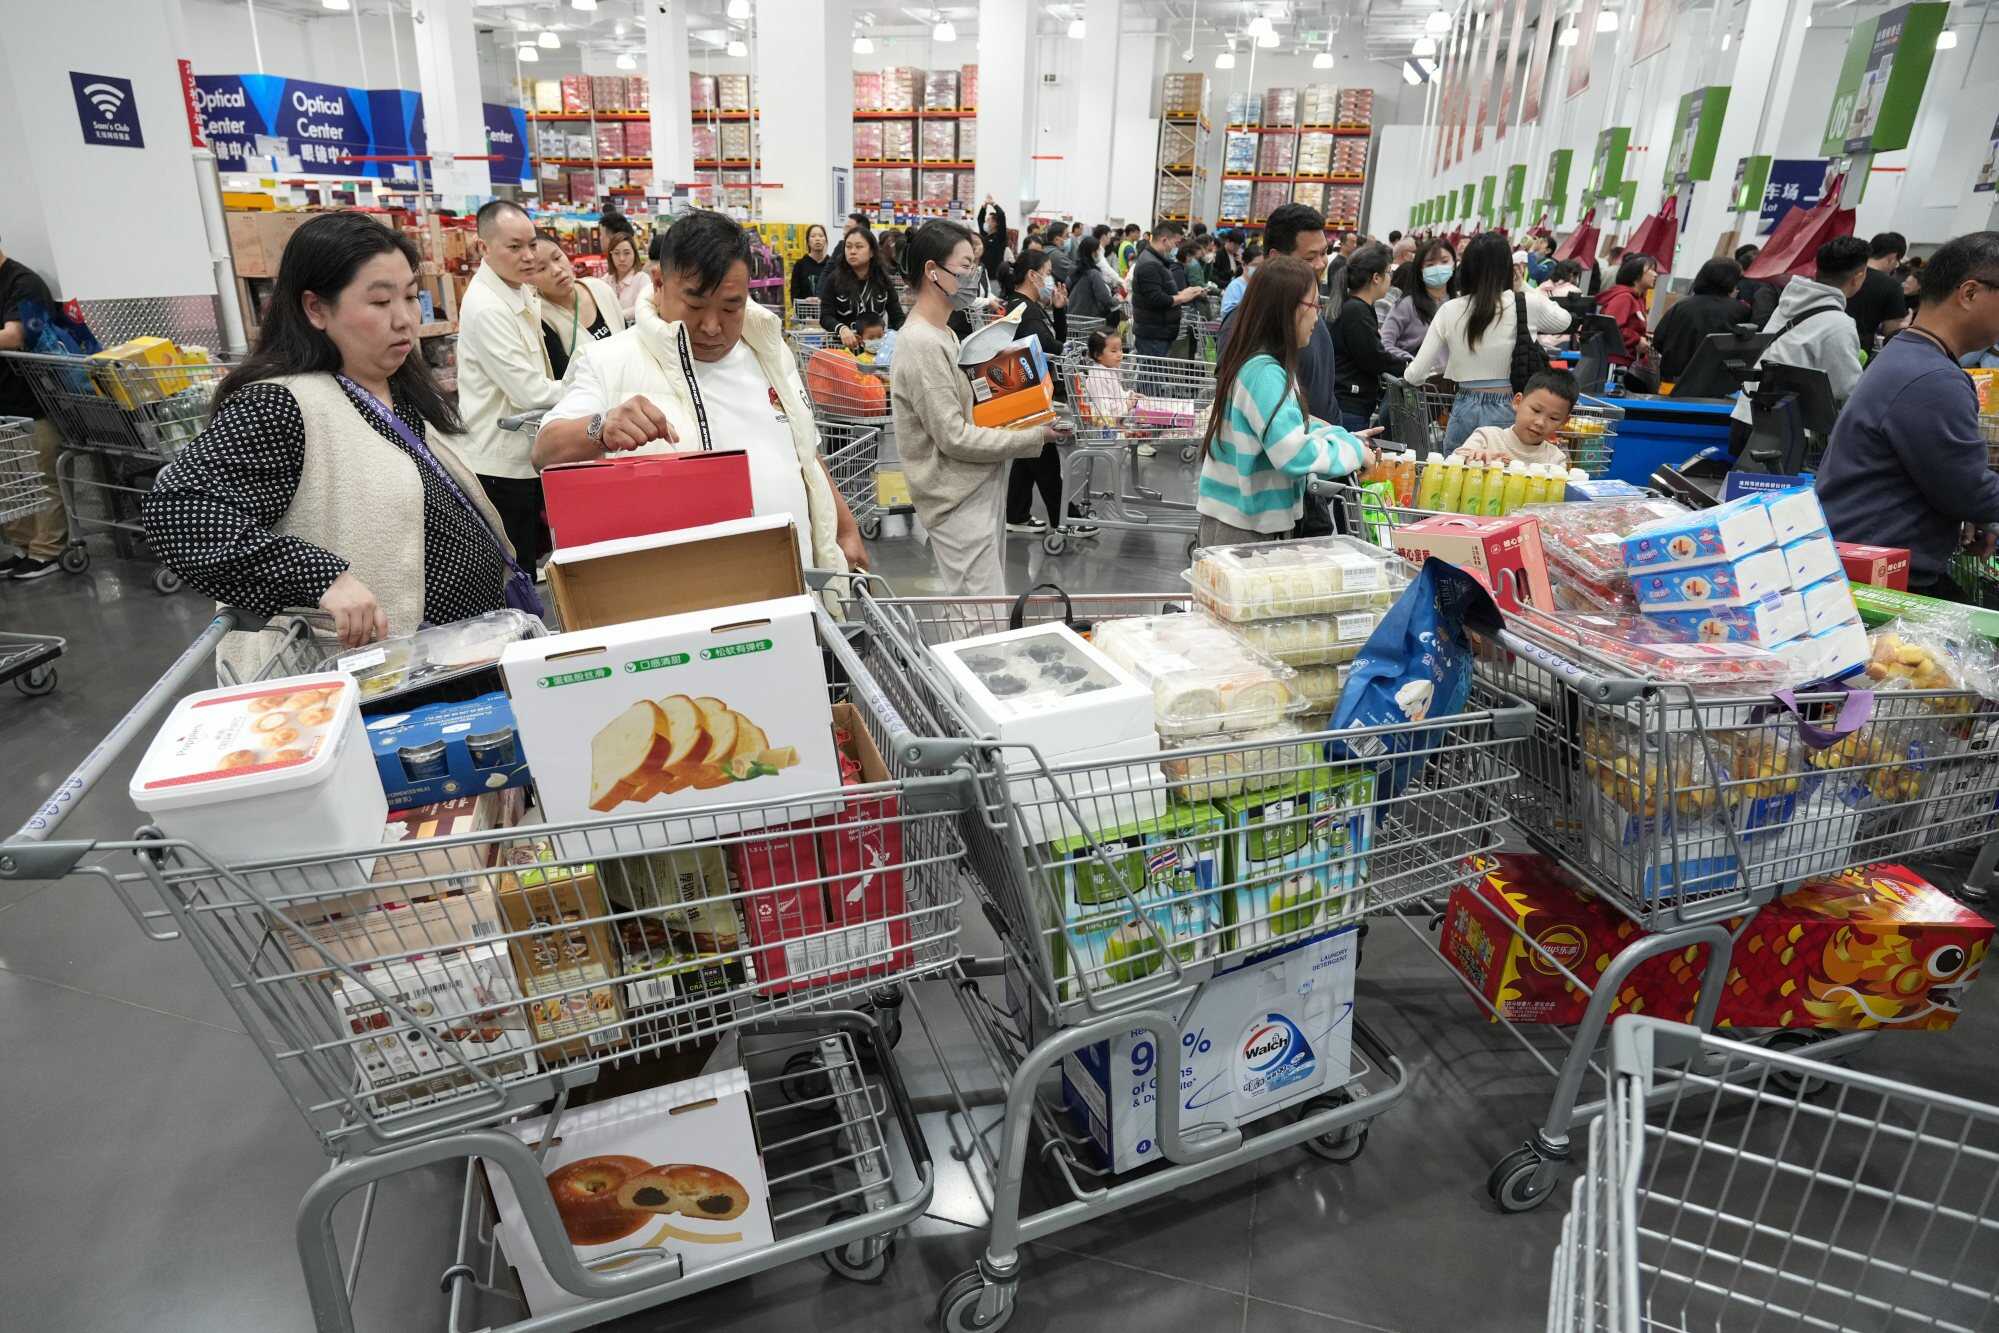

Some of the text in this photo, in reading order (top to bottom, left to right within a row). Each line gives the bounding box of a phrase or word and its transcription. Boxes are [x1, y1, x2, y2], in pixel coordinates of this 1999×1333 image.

[292, 91, 344, 116] Optical
[92, 121, 130, 132] Sam's Club
[1828, 95, 1852, 140] 06
[297, 118, 344, 140] Center
[301, 144, 353, 165] 眼镜中心
[1763, 203, 1778, 212] Lot
[1312, 955, 1348, 971] DETERGENT
[1320, 949, 1348, 961] LAUNDRY
[1245, 1036, 1289, 1060] Walch
[1132, 1082, 1145, 1095] of
